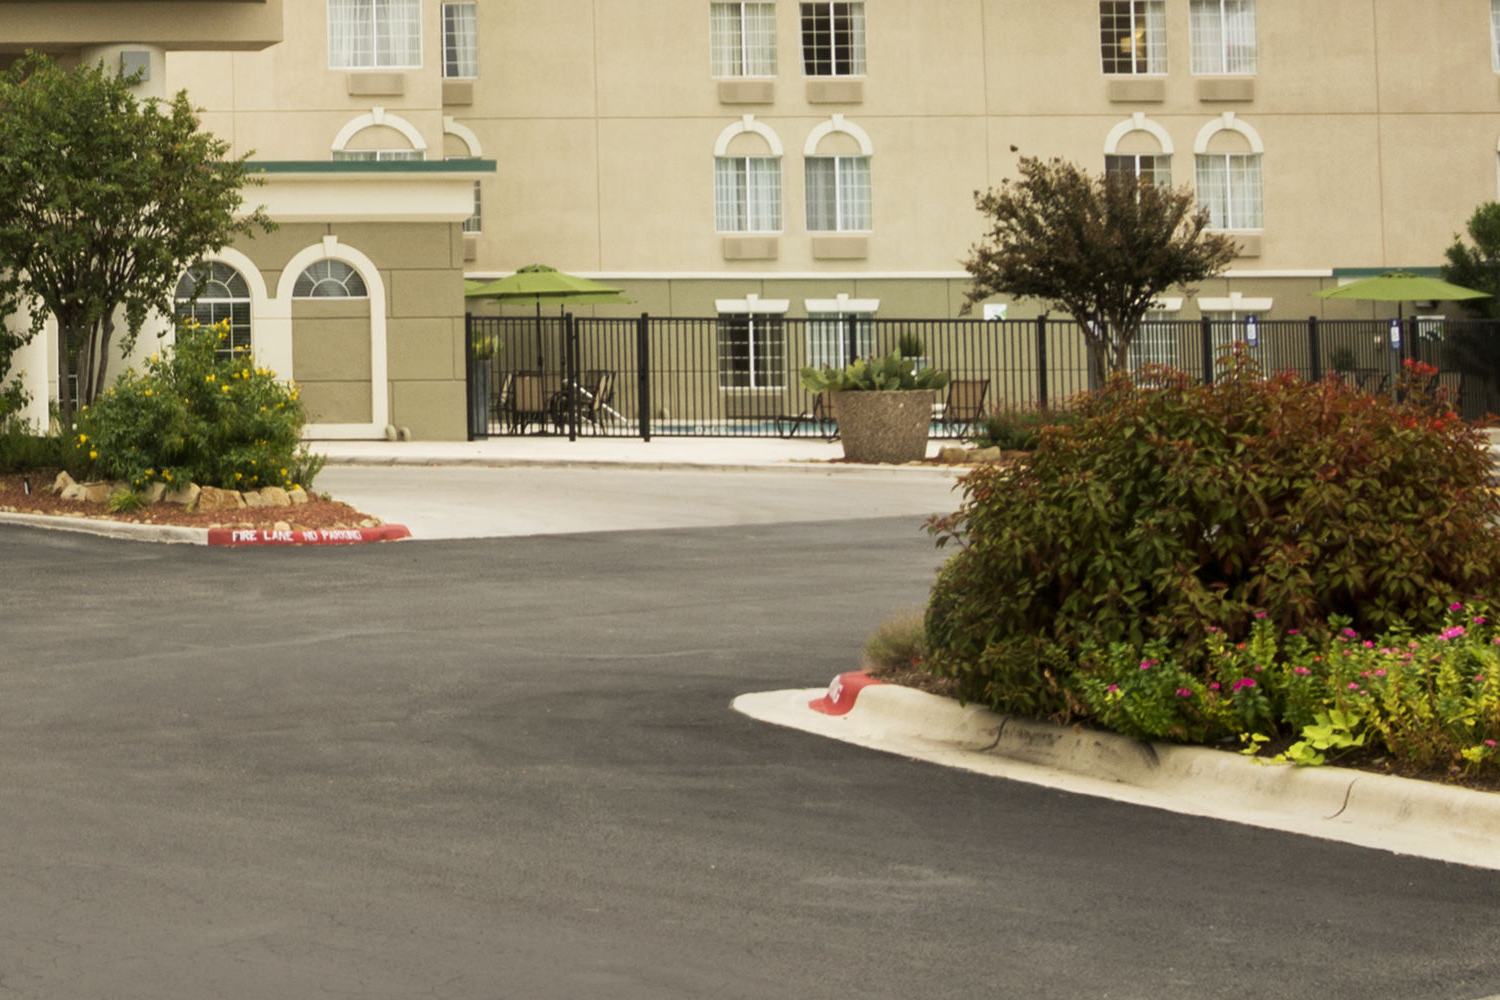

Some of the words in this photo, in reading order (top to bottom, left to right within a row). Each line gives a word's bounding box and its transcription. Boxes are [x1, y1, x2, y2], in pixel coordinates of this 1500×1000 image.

[232, 530, 257, 542] FIRE
[263, 530, 294, 542] LANE
[302, 530, 318, 541] NO
[320, 529, 362, 541] PARKING
